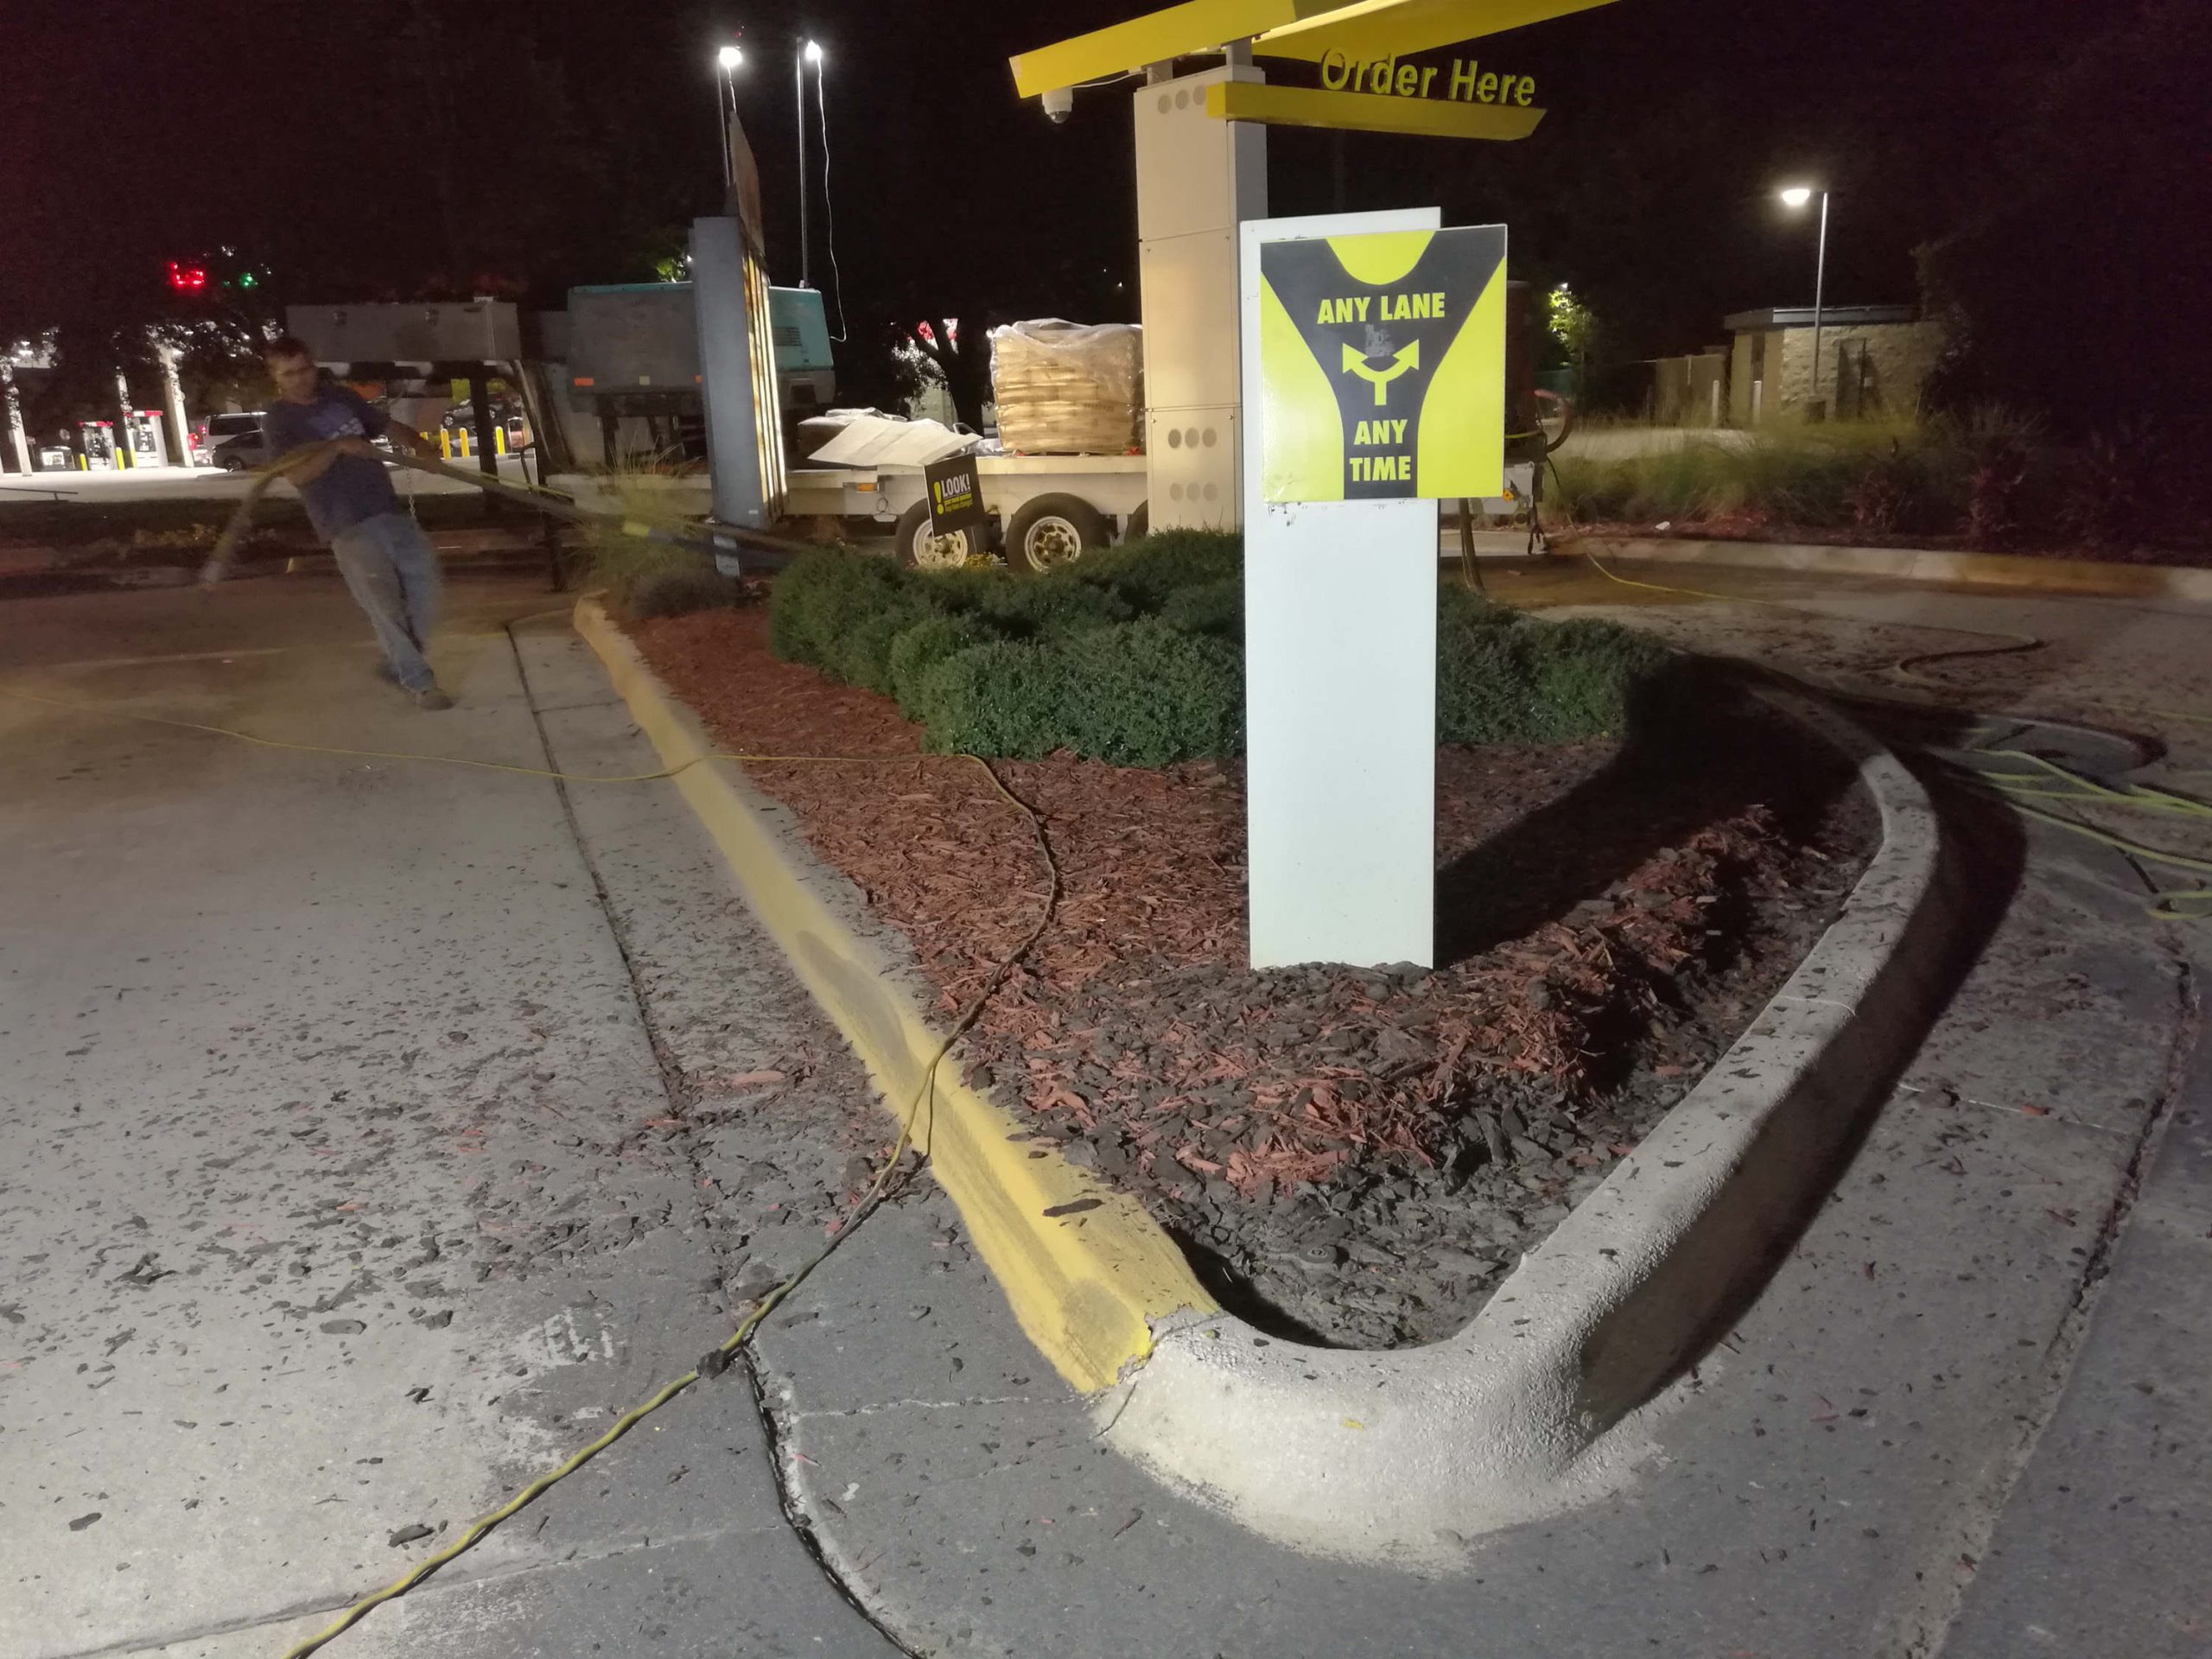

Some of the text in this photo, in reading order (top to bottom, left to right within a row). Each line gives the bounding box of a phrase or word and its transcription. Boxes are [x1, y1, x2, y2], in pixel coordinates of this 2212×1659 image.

[1320, 47, 1535, 106] Order Here
[1317, 292, 1446, 324] ANY LANE
[1353, 419, 1408, 445] ANY
[1349, 455, 1411, 481] TIME
[941, 473, 971, 498] LOOK!
